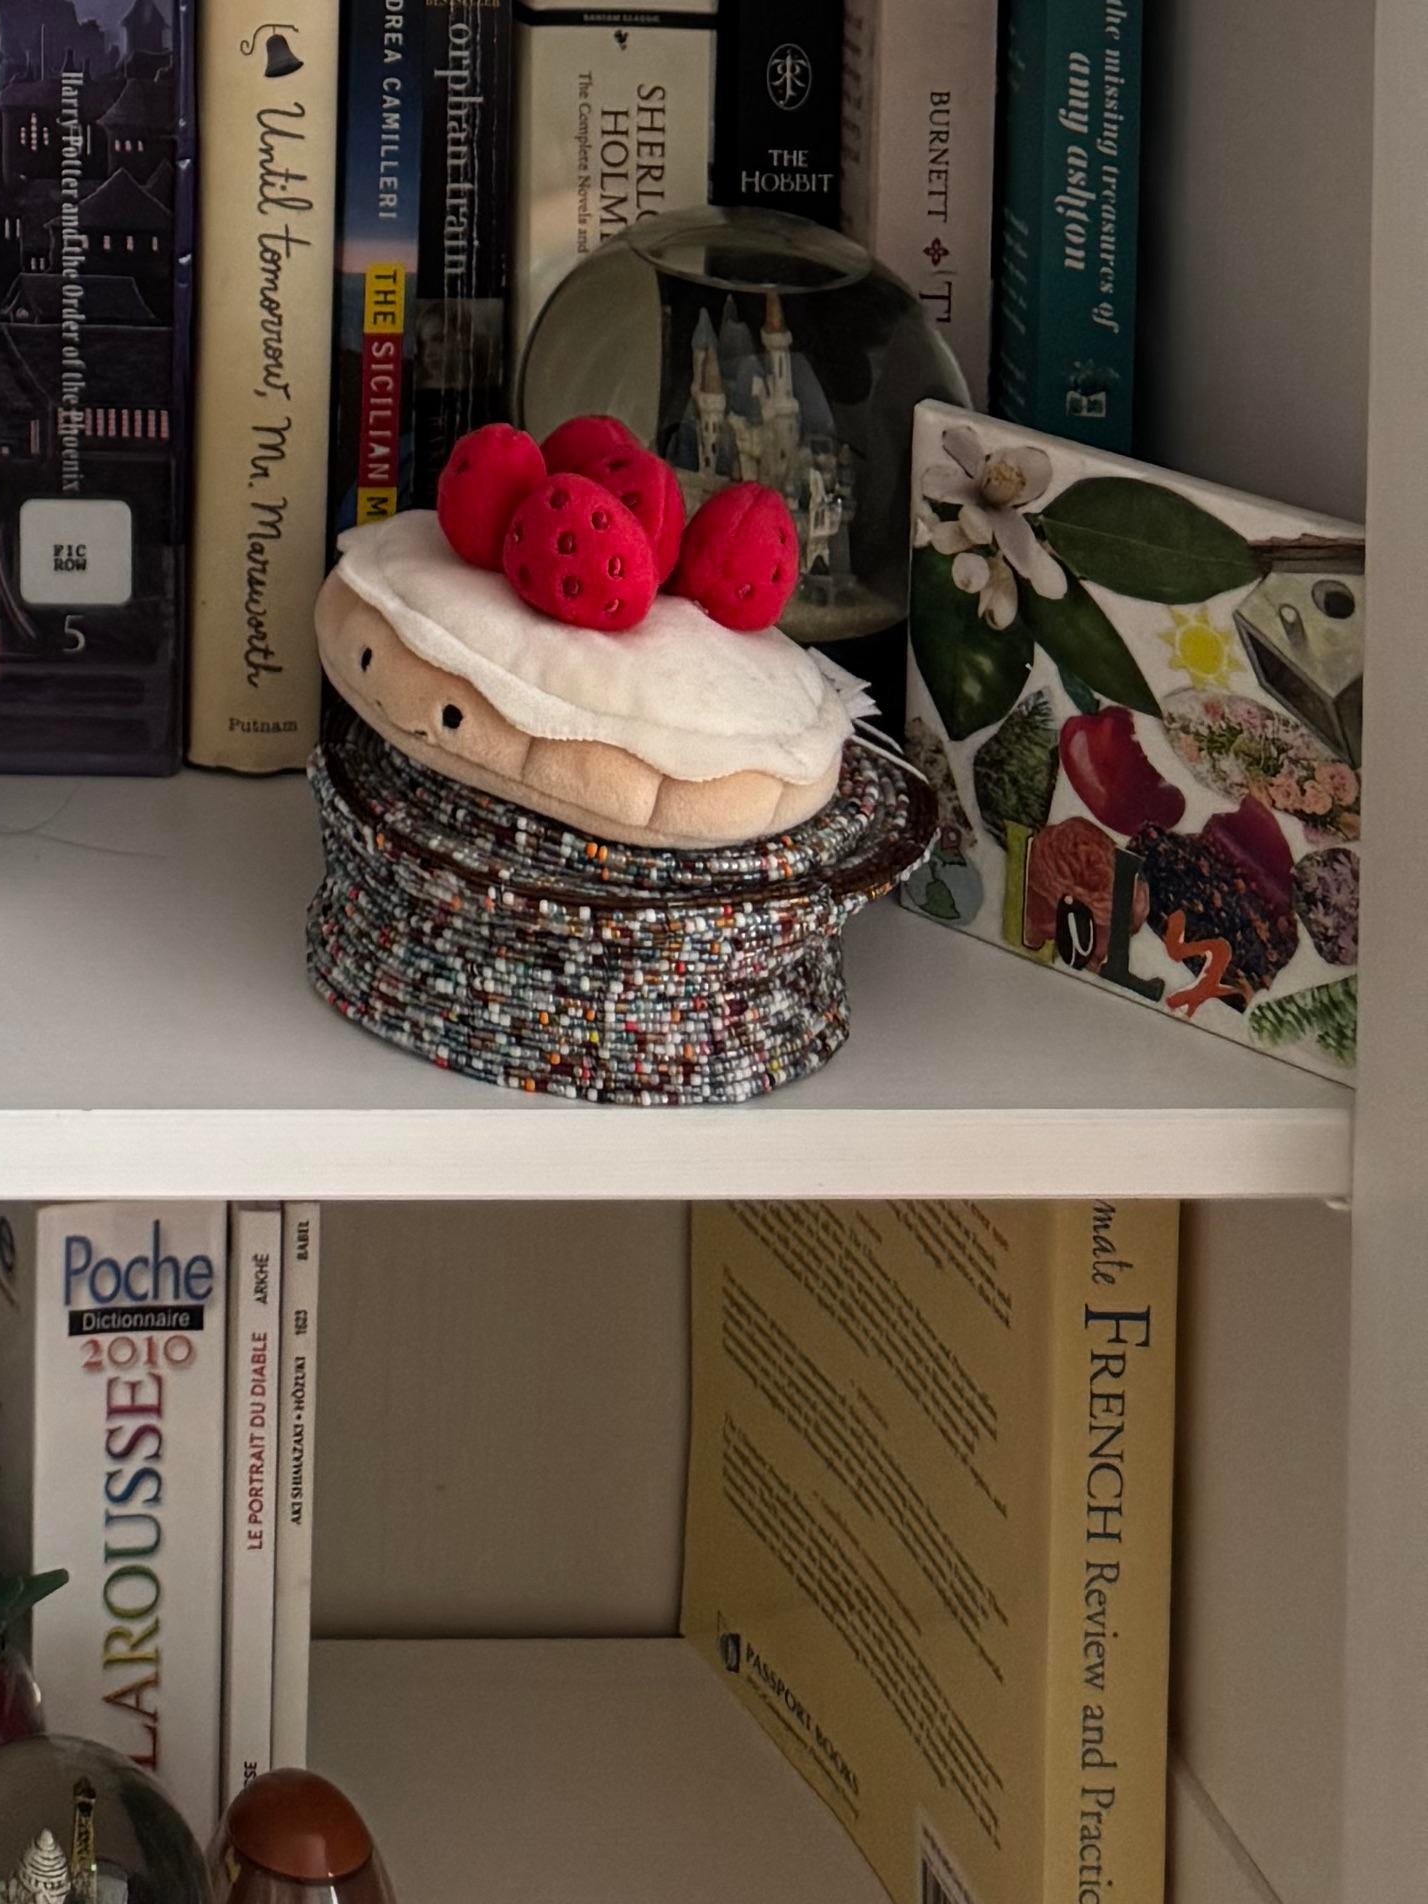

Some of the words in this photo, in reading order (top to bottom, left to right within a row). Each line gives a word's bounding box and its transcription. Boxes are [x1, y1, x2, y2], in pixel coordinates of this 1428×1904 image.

[378, 77, 402, 221] CAMILLERI
[768, 150, 809, 168] THE
[929, 91, 950, 222] BURNETT
[228, 717, 299, 735] Putnam
[63, 1219, 213, 1306] Poche
[82, 1310, 190, 1330] Dictionnaire
[82, 1335, 196, 1372] 2010
[1083, 1305, 1151, 1545] FRENCH
[102, 1372, 164, 1772] LAROUSSE
[1082, 1560, 1121, 1692] Review
[1080, 1704, 1116, 1770] and
